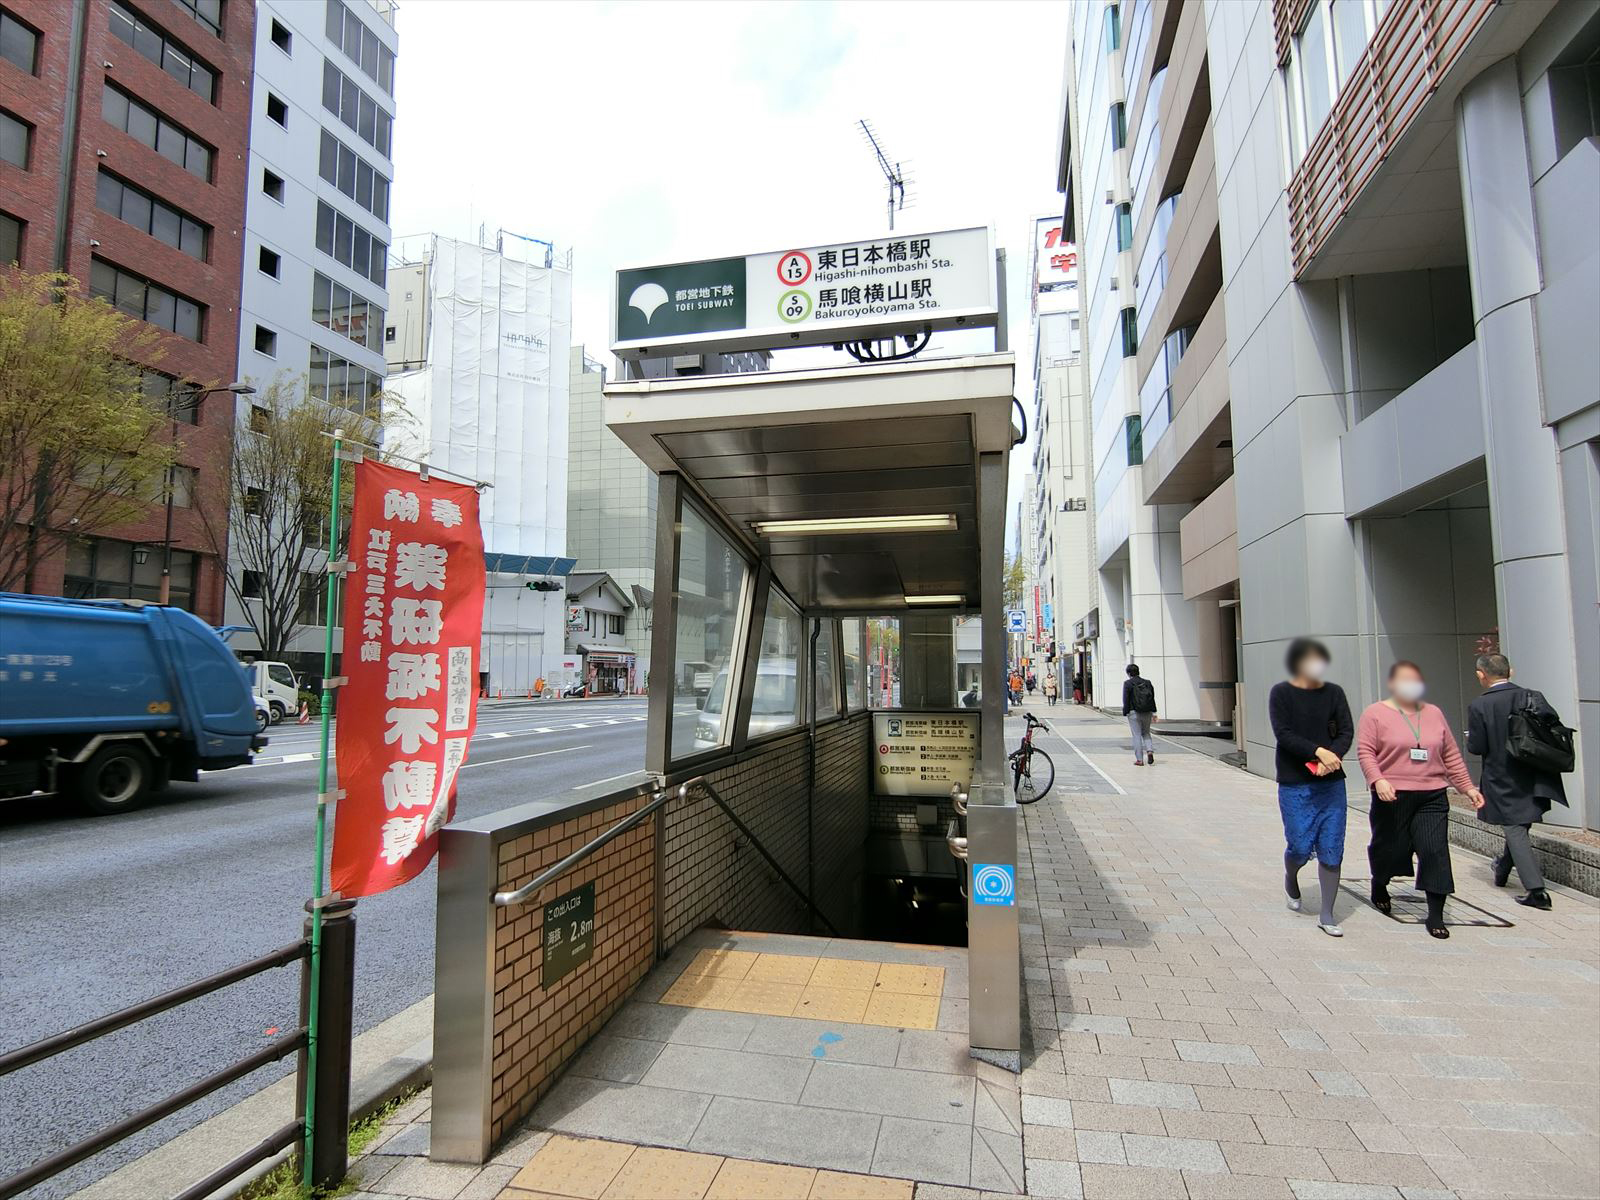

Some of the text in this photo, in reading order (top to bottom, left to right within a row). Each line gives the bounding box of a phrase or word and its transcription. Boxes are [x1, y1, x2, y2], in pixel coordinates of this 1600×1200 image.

[790, 258, 799, 267] A
[817, 239, 932, 270] 東日本橋駅
[787, 268, 803, 279] 15
[814, 257, 954, 283] Higashi-nihombashi Sta.
[675, 284, 734, 302] 都営地下鉄
[791, 295, 798, 305] S
[818, 278, 932, 309] 馬喰横山駅
[675, 298, 734, 312] TOEI SUBWAY
[786, 305, 803, 317] 09
[815, 301, 941, 320] Bakuroyokoyama Sta.
[570, 919, 593, 942] 2.8m
